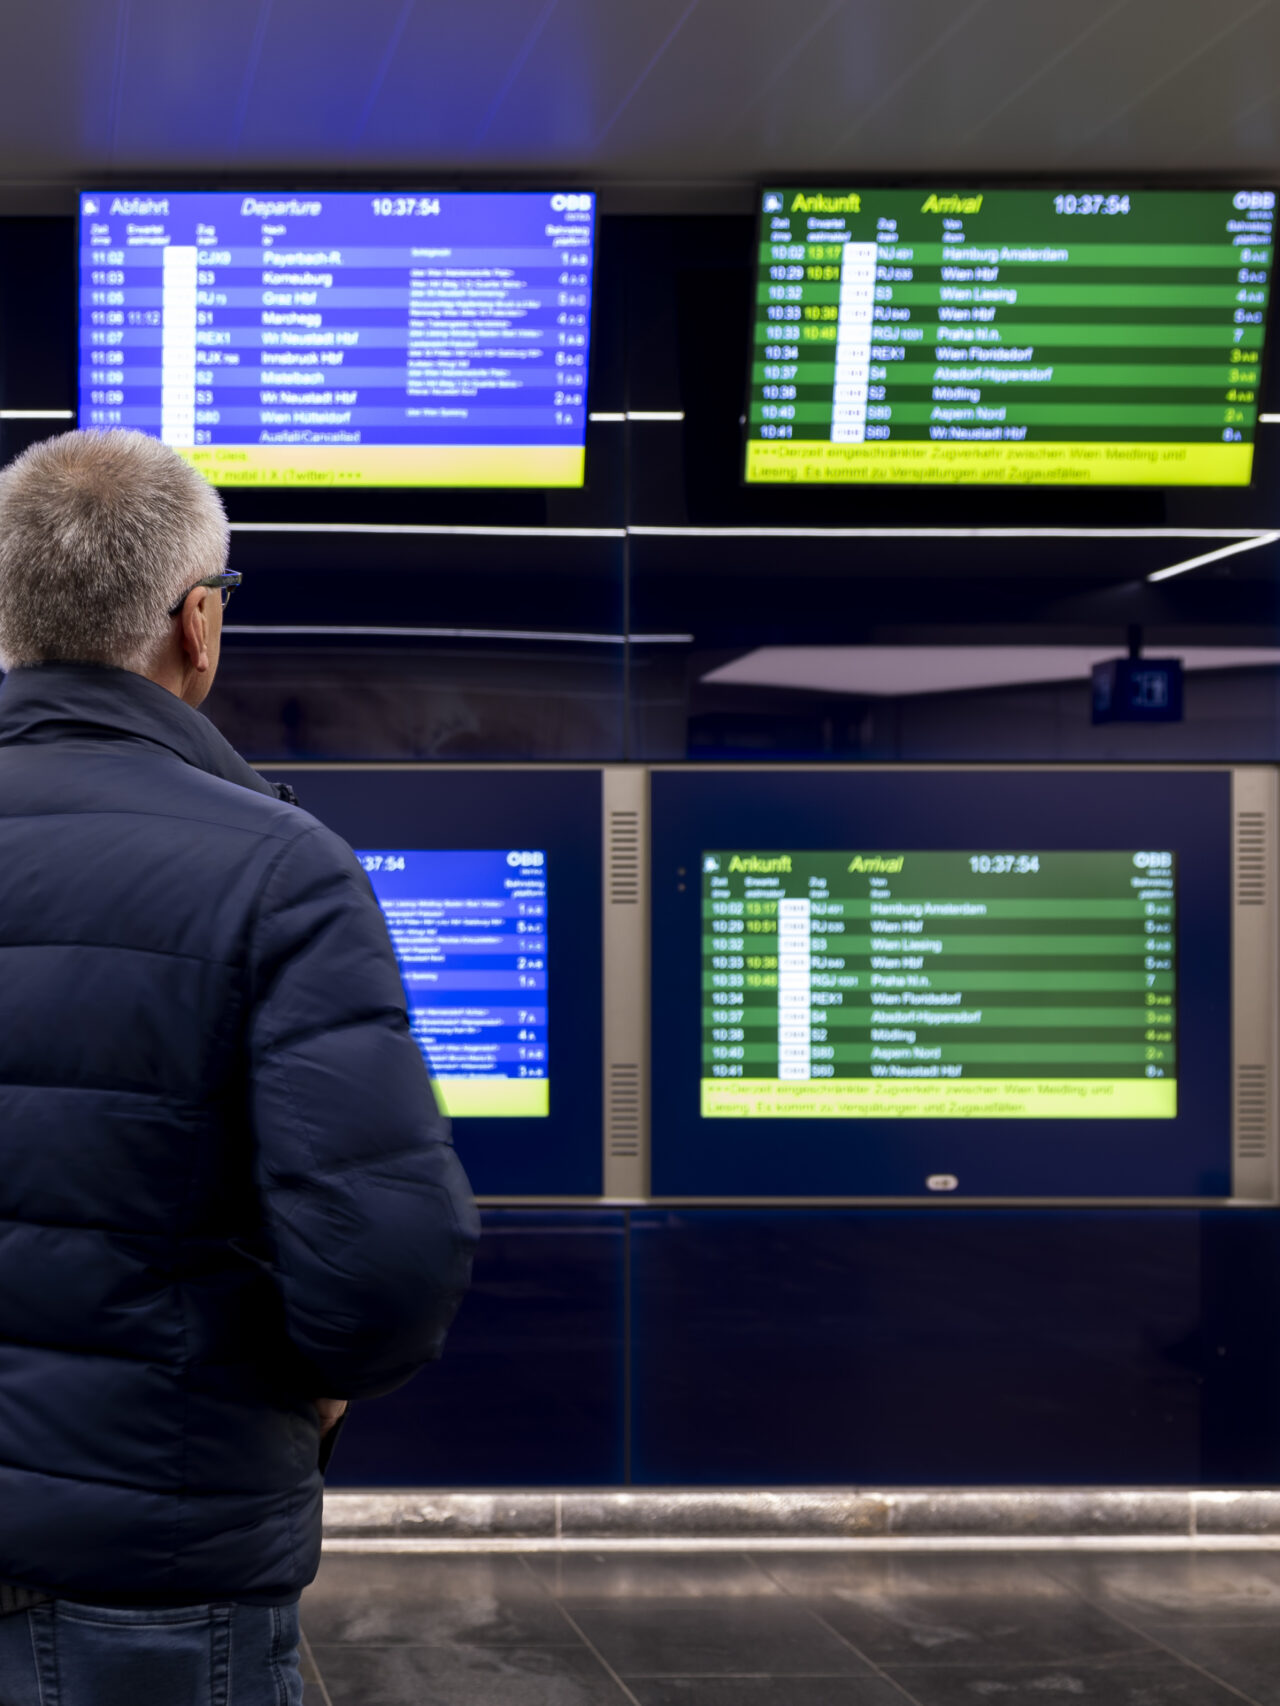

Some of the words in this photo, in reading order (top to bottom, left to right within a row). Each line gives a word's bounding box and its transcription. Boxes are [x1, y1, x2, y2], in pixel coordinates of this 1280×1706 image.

[110, 199, 170, 215] Abfahrt
[241, 198, 321, 219] Departure
[372, 198, 440, 216] 10:37:54
[790, 193, 861, 213] Ankunft
[921, 193, 983, 213] Arrival
[1054, 194, 1131, 215] 10:37:54
[729, 856, 792, 873] Ankunft
[848, 856, 904, 873] Arrival
[969, 855, 1040, 873] 10:37:54
